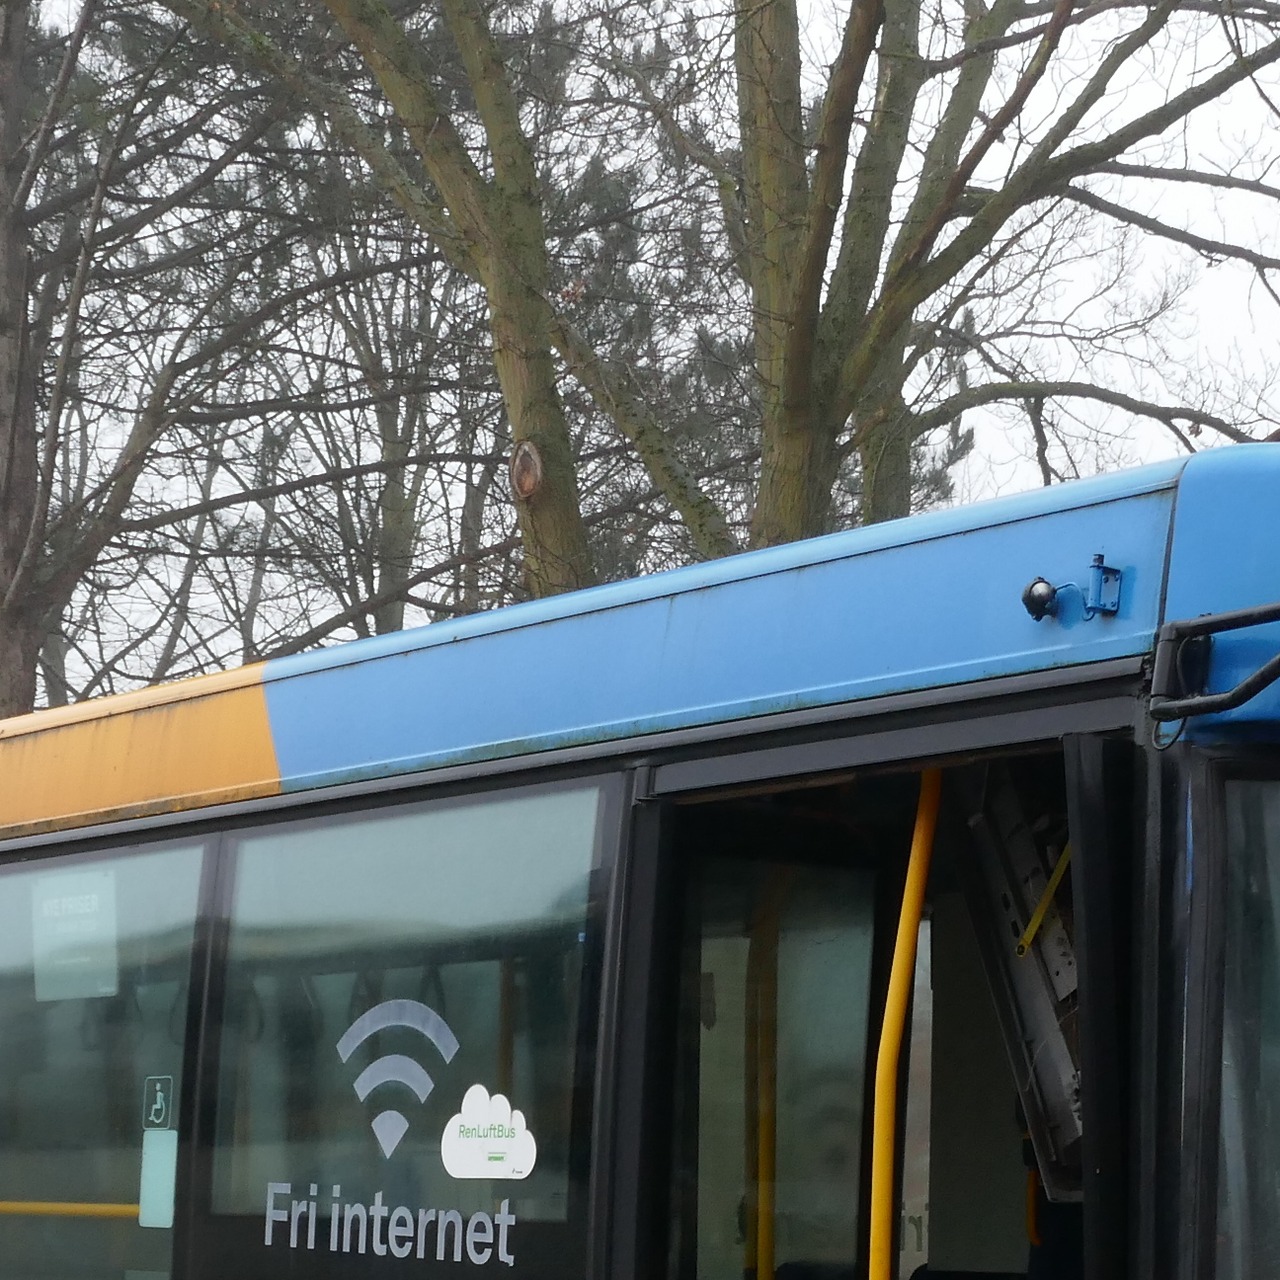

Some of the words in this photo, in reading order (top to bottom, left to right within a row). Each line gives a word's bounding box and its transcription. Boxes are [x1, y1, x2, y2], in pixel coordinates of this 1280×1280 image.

[459, 1124, 516, 1138] RenLuftBus
[265, 1182, 317, 1250] Fri
[330, 1184, 516, 1267] internet
